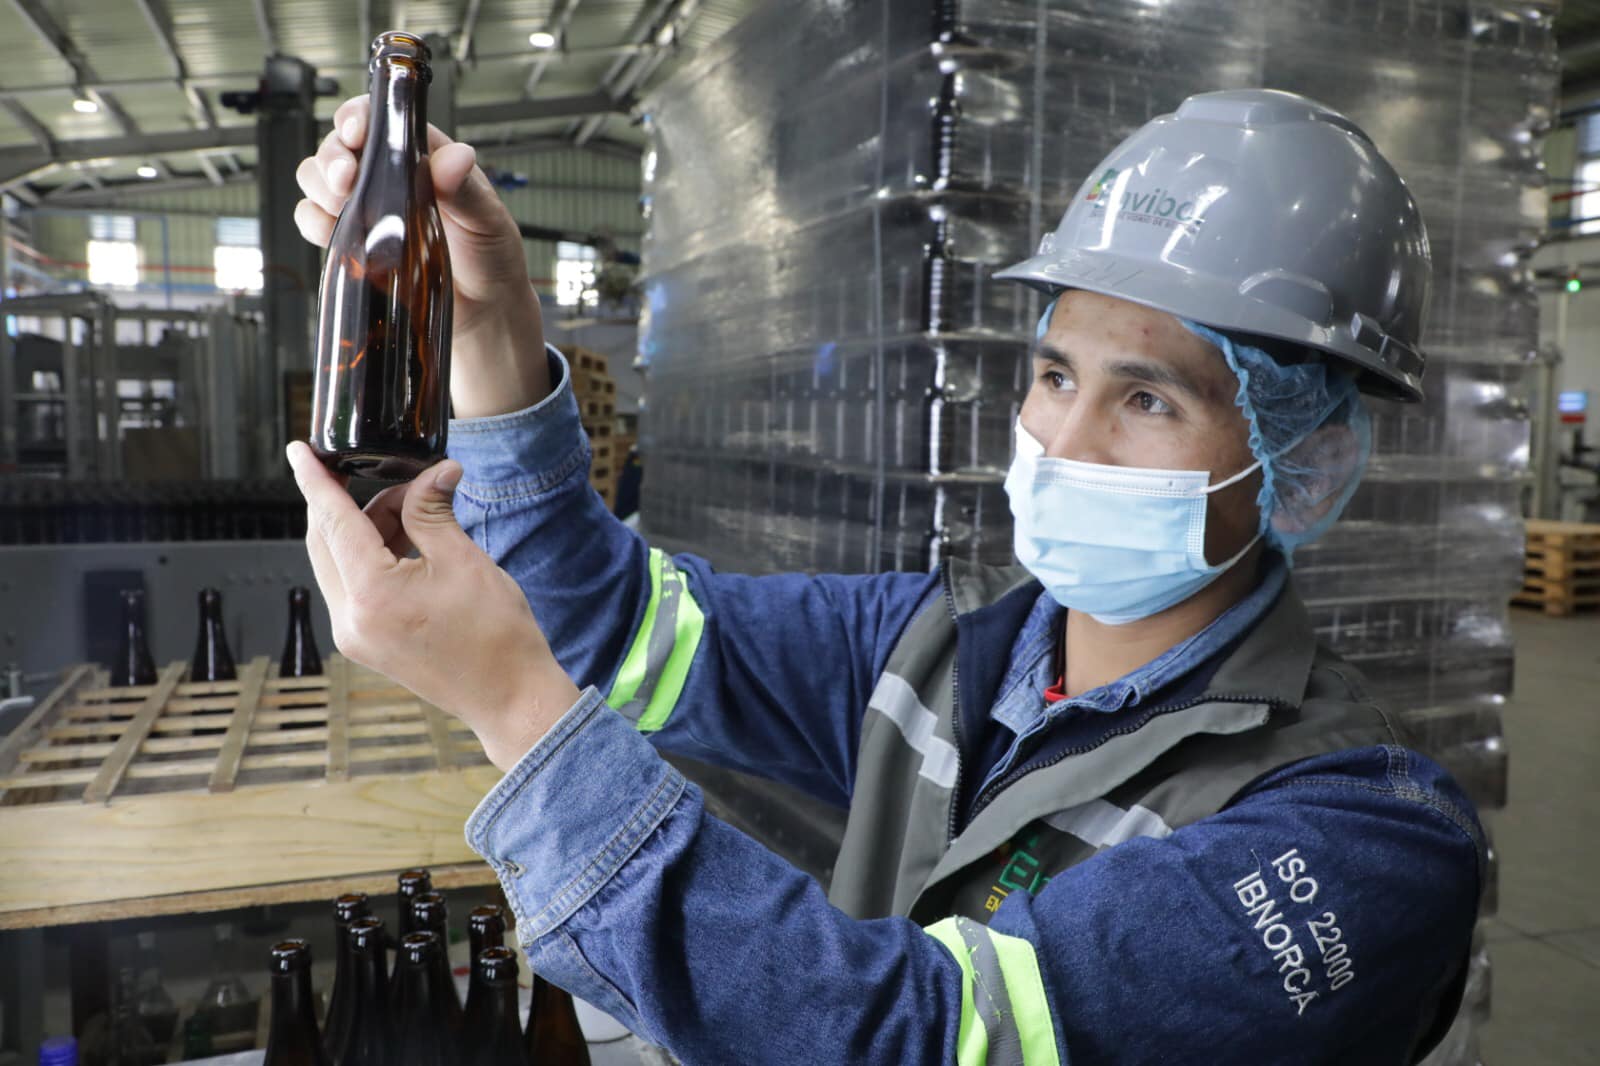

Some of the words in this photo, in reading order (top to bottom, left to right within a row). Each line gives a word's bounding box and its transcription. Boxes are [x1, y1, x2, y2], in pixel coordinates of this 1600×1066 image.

[1093, 181, 1205, 226] Envibo
[1233, 871, 1320, 1015] IBNORCA
[1271, 848, 1319, 904] ISO
[1307, 911, 1355, 991] 22000
